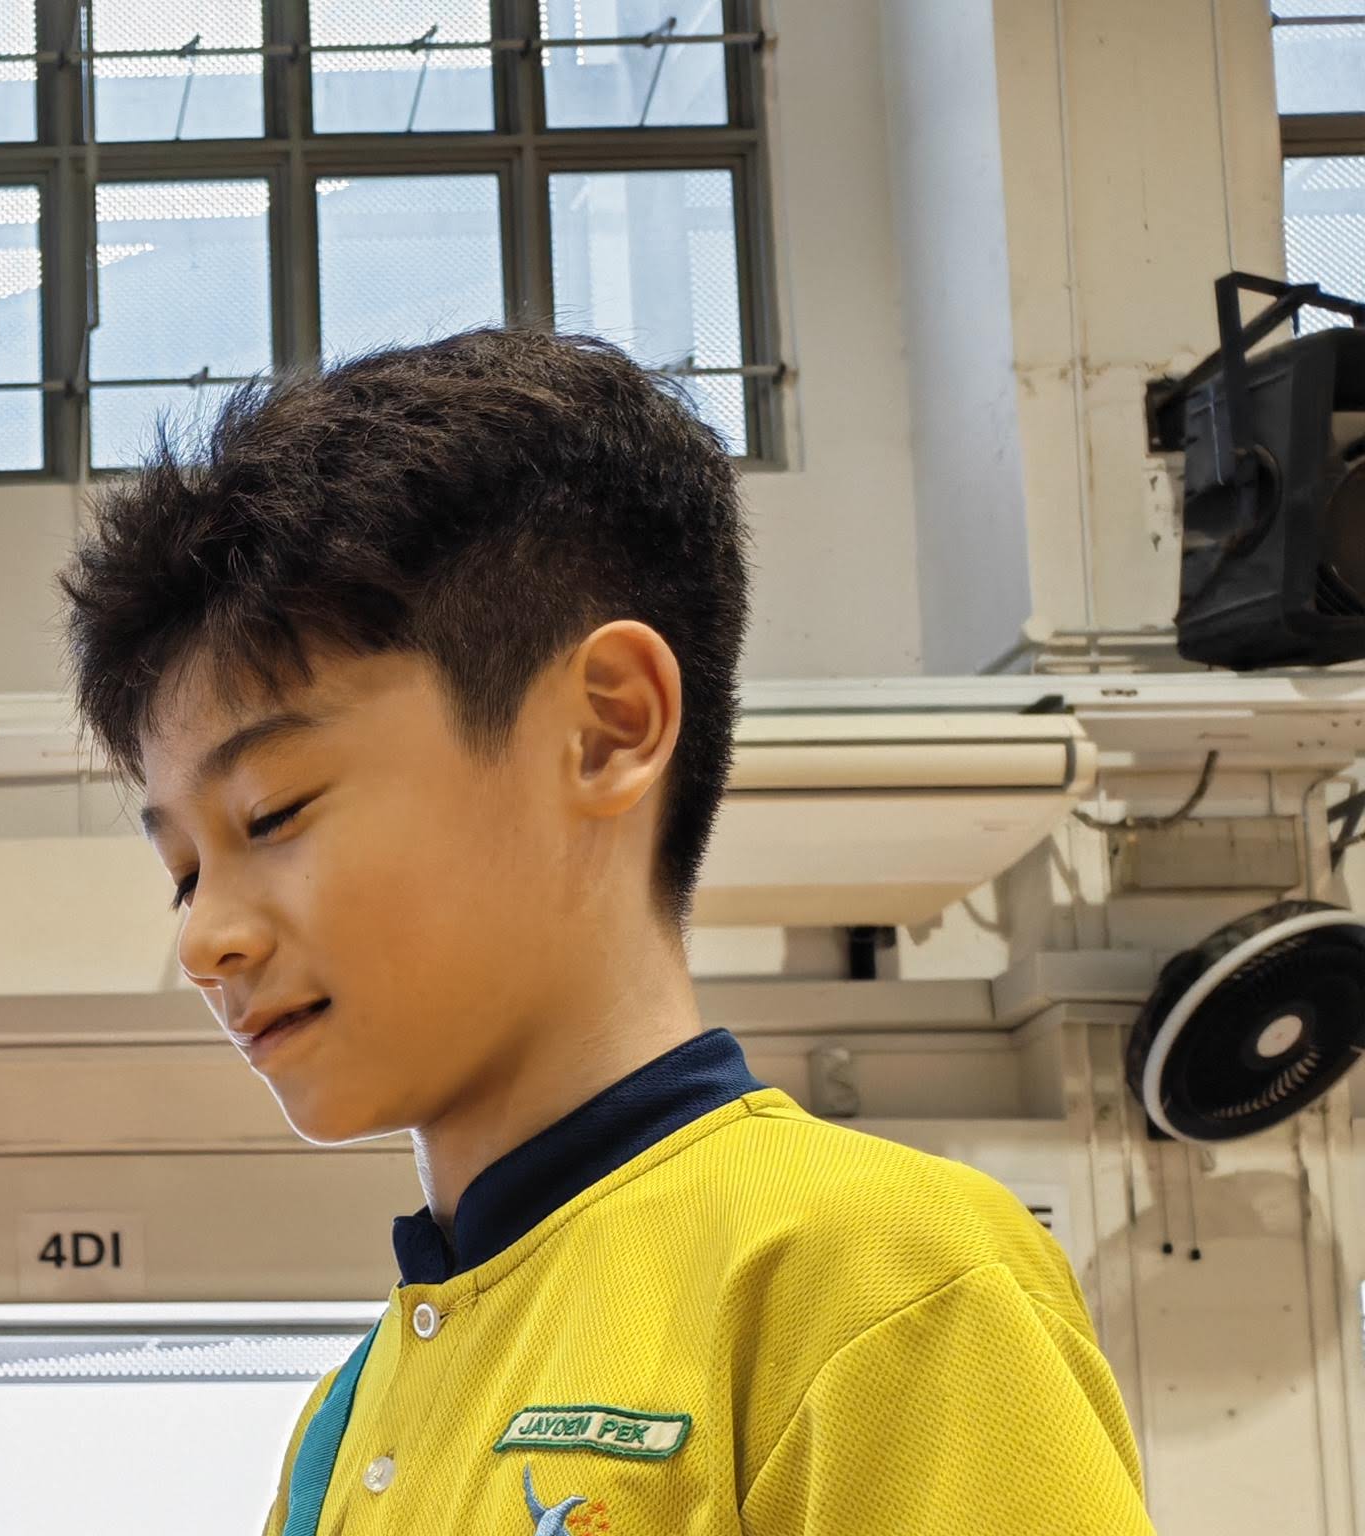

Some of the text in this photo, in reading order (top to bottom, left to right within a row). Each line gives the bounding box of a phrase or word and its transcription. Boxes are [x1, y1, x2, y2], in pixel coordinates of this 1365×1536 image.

[38, 1231, 122, 1269] 4DI
[519, 1415, 652, 1445] JAYDEN PEK
